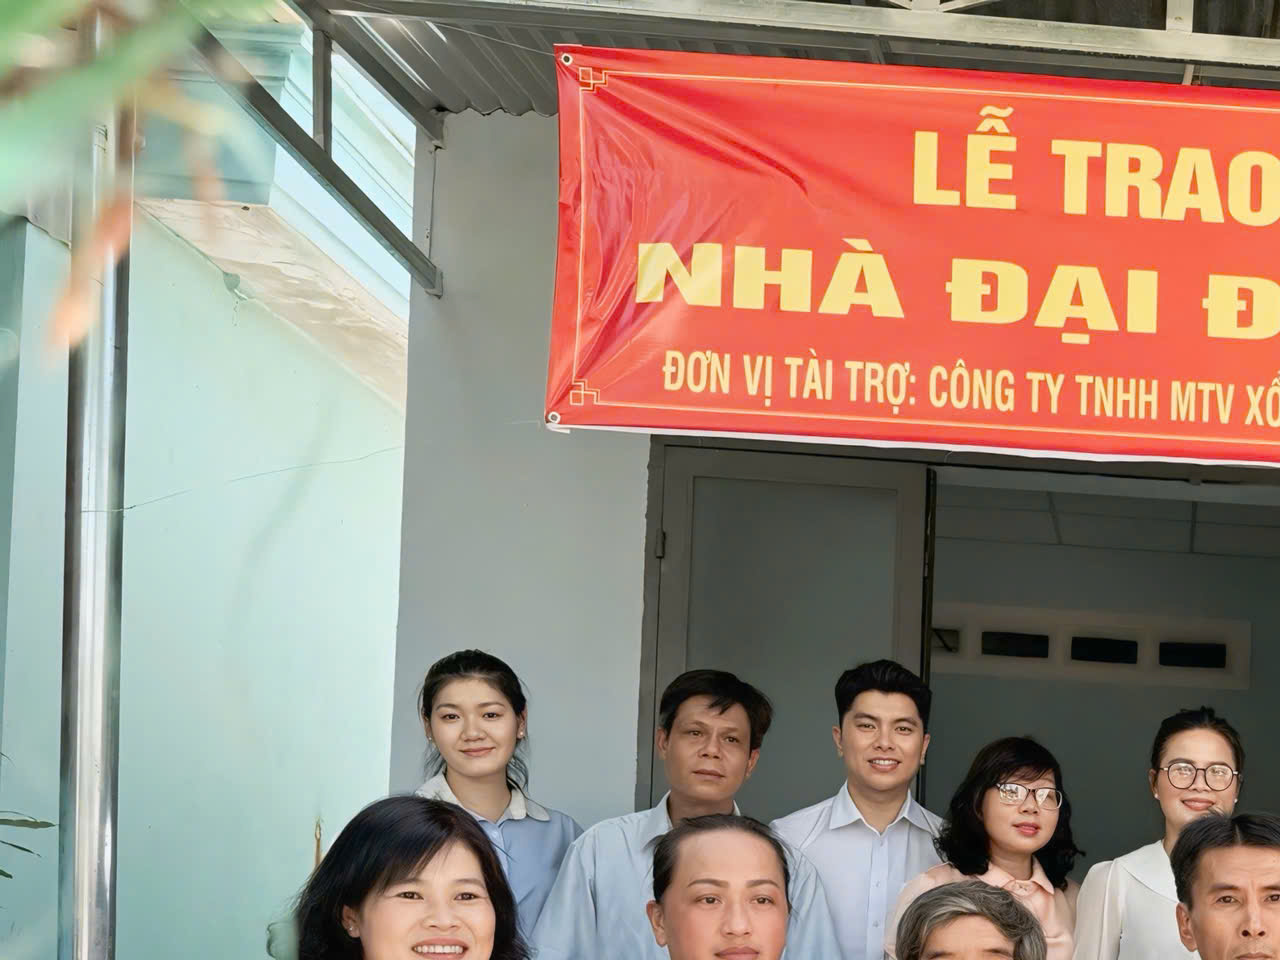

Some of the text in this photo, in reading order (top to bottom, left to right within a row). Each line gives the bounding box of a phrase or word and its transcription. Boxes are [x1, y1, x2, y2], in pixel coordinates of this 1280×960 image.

[914, 105, 1016, 210] LỄ
[636, 238, 904, 318] NHÀ
[945, 258, 1158, 345] ĐẠI
[662, 348, 731, 394] ĐƠN
[743, 354, 773, 407] VỊ
[785, 347, 833, 401] TÀI
[844, 359, 916, 415] TRỢ:
[929, 358, 1015, 412] CÔNG
[1025, 371, 1065, 414] TY
[1074, 374, 1158, 420] TNHH
[1170, 380, 1235, 425] MTV
